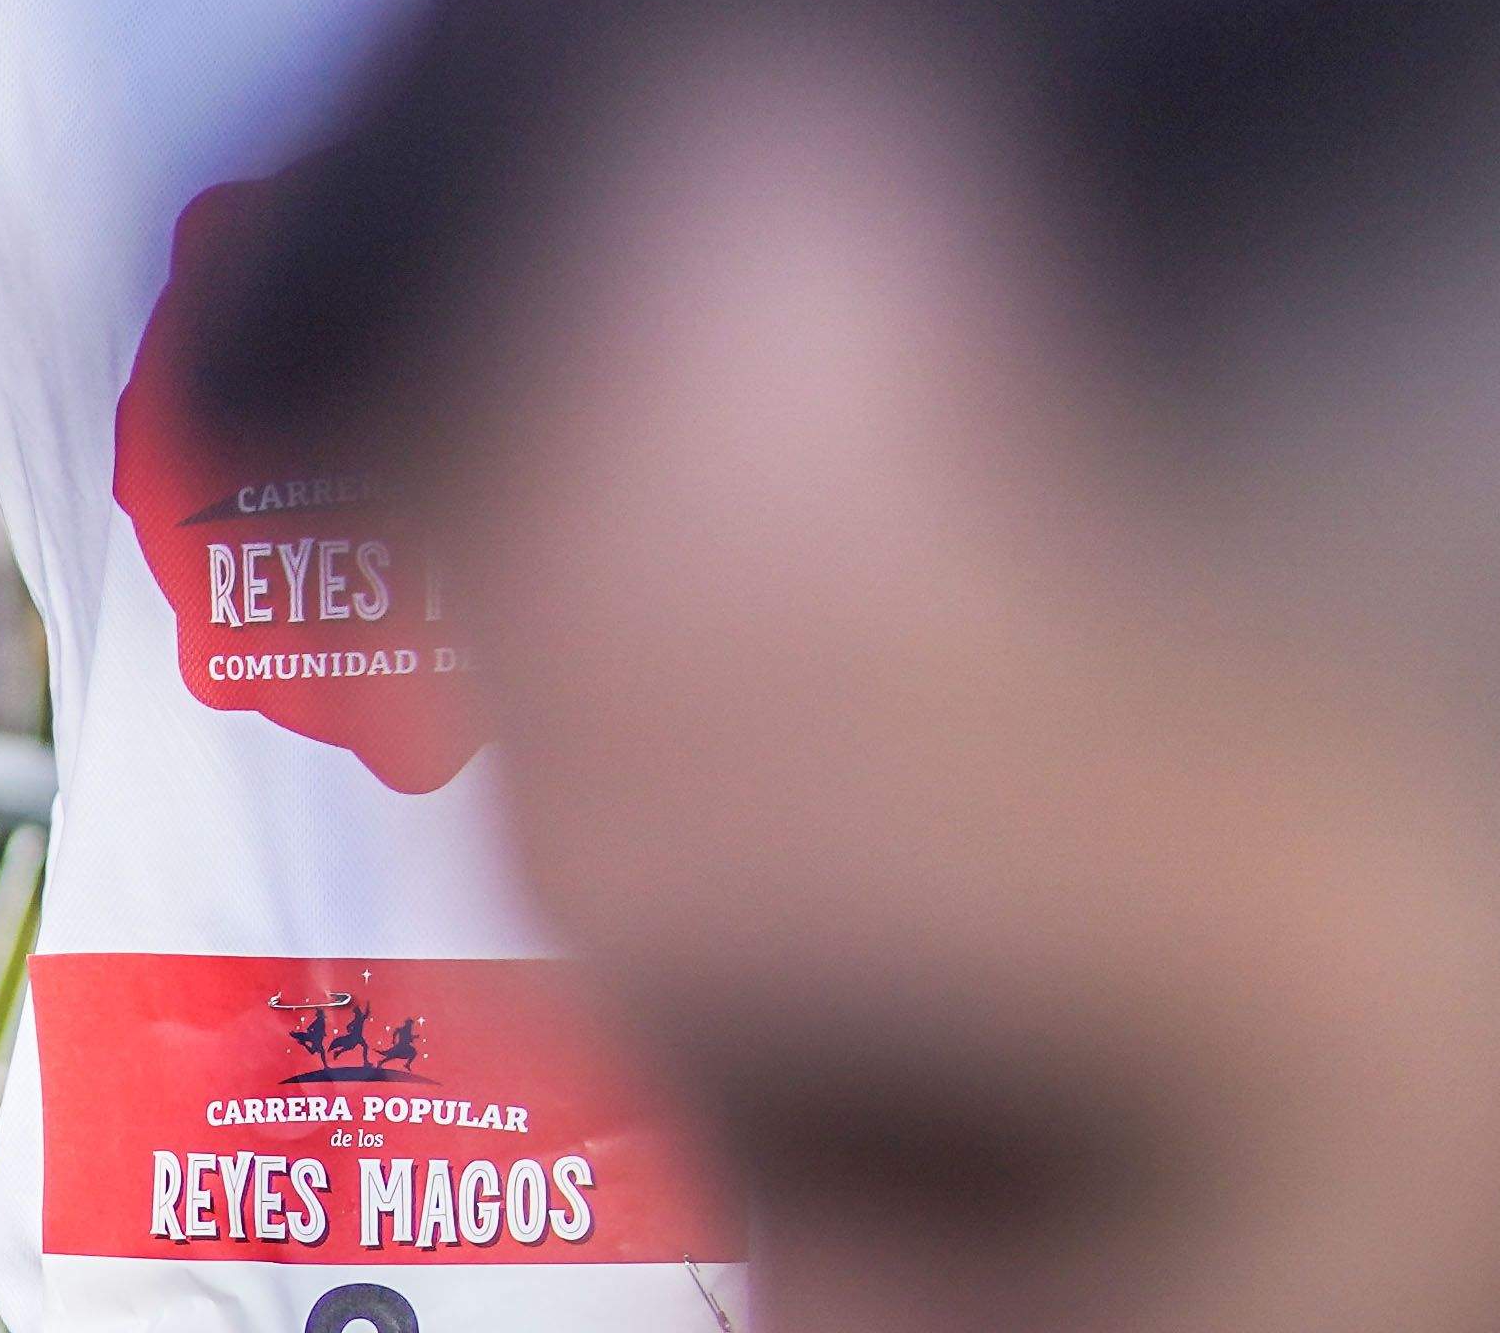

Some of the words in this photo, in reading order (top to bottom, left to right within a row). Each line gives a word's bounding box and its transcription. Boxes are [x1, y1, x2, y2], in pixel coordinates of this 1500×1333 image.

[206, 537, 391, 628] REYES
[207, 648, 418, 682] COMUNIDAD
[206, 1096, 353, 1127] CARRERA
[362, 1096, 529, 1133] POPULAR
[329, 1129, 353, 1148] de
[357, 1129, 385, 1149] los
[149, 1149, 332, 1245] REYES
[357, 1155, 595, 1251] MAGOS
